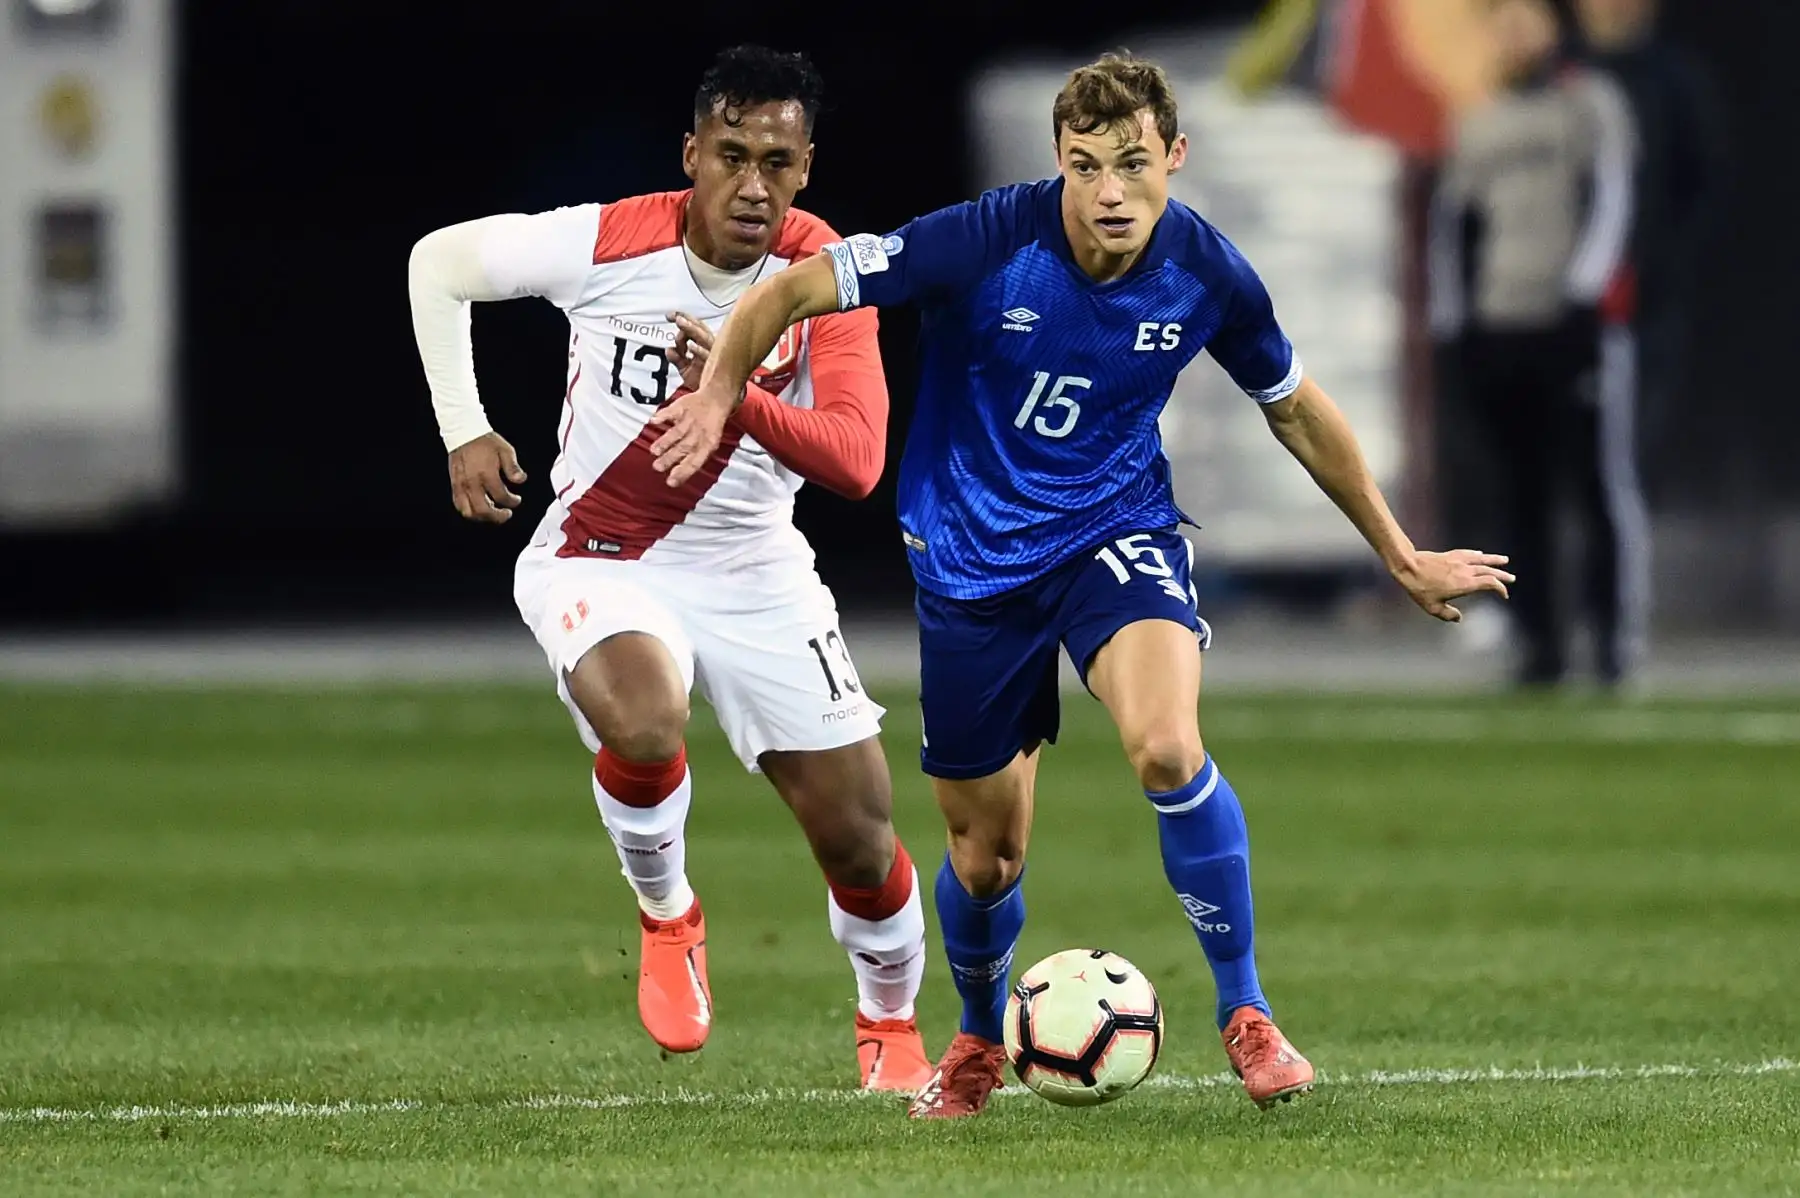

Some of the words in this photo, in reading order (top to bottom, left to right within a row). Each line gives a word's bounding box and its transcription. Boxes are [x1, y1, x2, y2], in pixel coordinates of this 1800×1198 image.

[608, 316, 676, 342] maratho
[1002, 323, 1033, 332] umbro
[1133, 322, 1182, 351] ES
[611, 336, 670, 406] 13
[1013, 371, 1093, 438] 15
[1094, 534, 1173, 585] 15
[808, 629, 859, 702] 13
